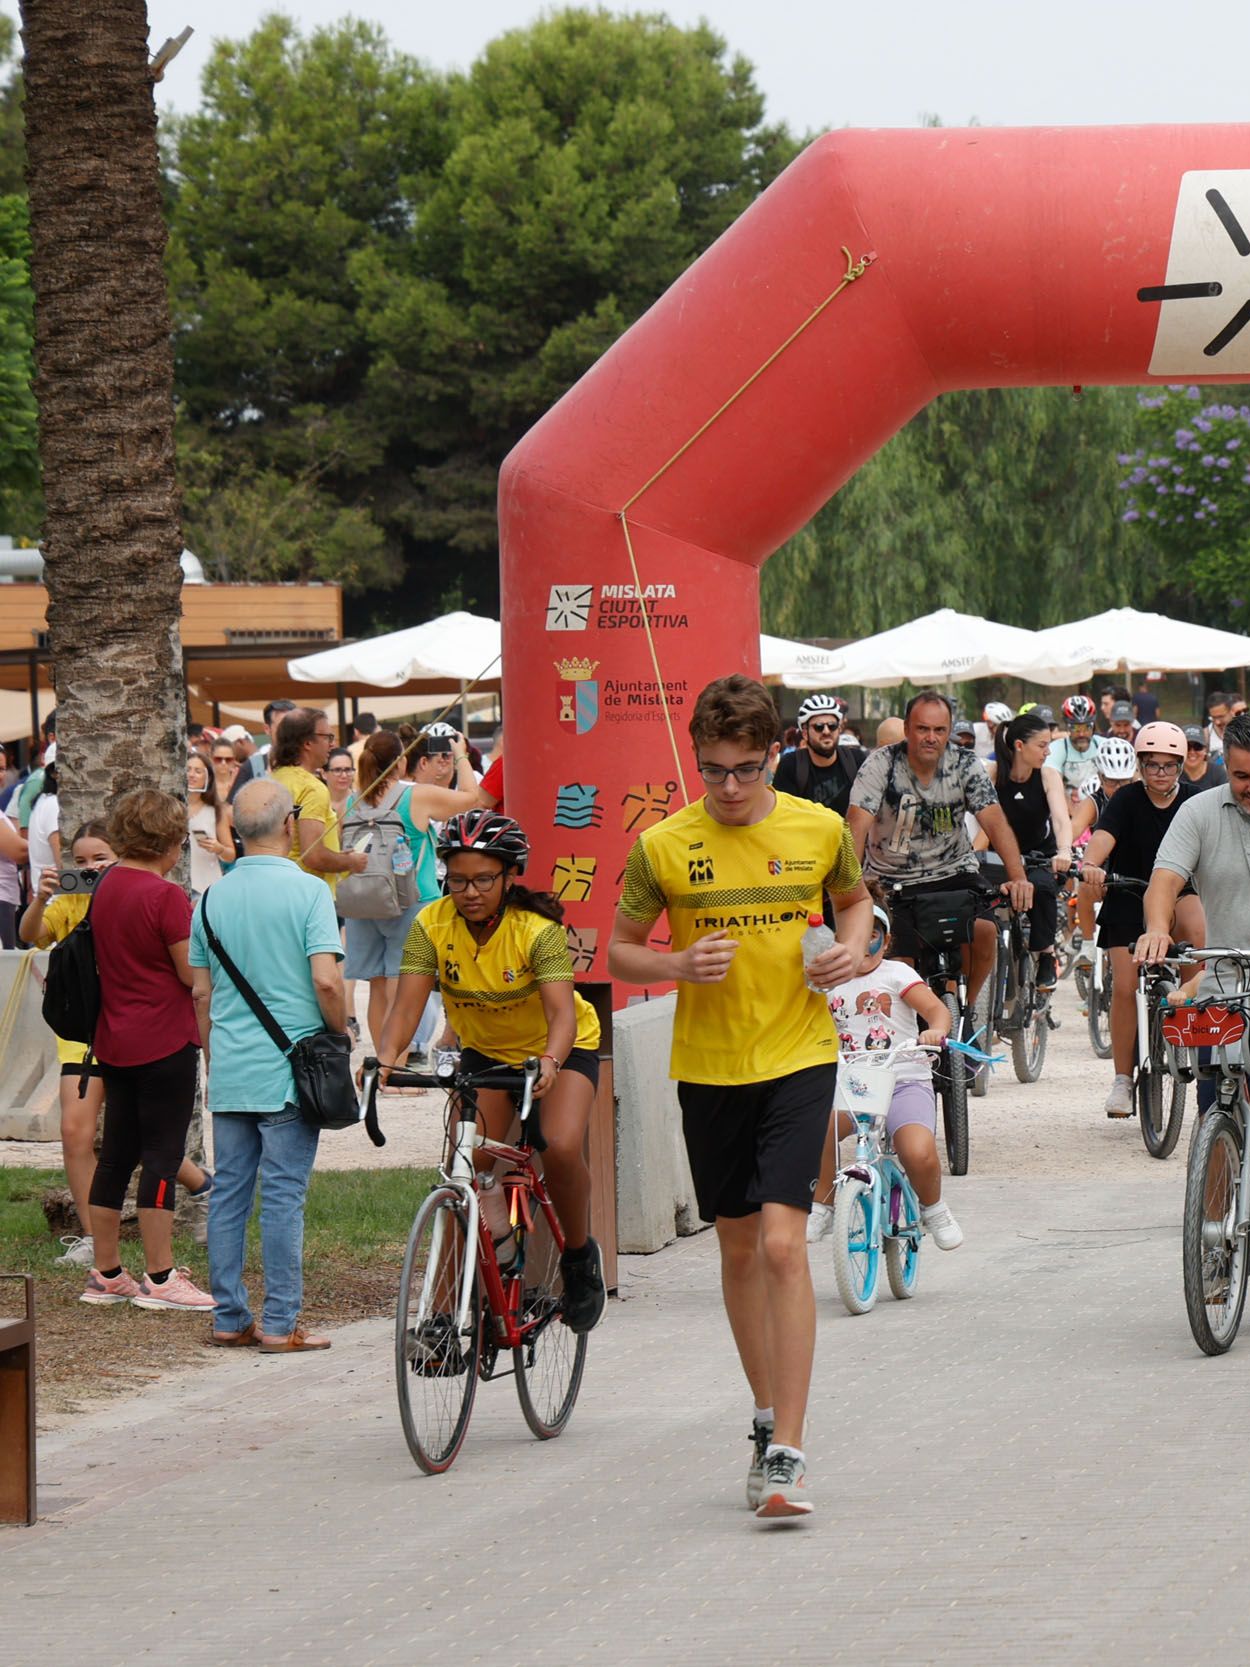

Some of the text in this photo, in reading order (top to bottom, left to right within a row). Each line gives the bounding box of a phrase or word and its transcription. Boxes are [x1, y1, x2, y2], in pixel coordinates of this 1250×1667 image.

[601, 584, 677, 598] MISLATA
[599, 600, 659, 614] CIUTAT
[597, 615, 689, 629] ESPORTIVA
[603, 680, 688, 694] Ajuntament
[604, 694, 622, 706] de
[644, 711, 681, 723] d'Esprts
[695, 910, 808, 928] TRIATHLON
[730, 927, 782, 937] ISLATA
